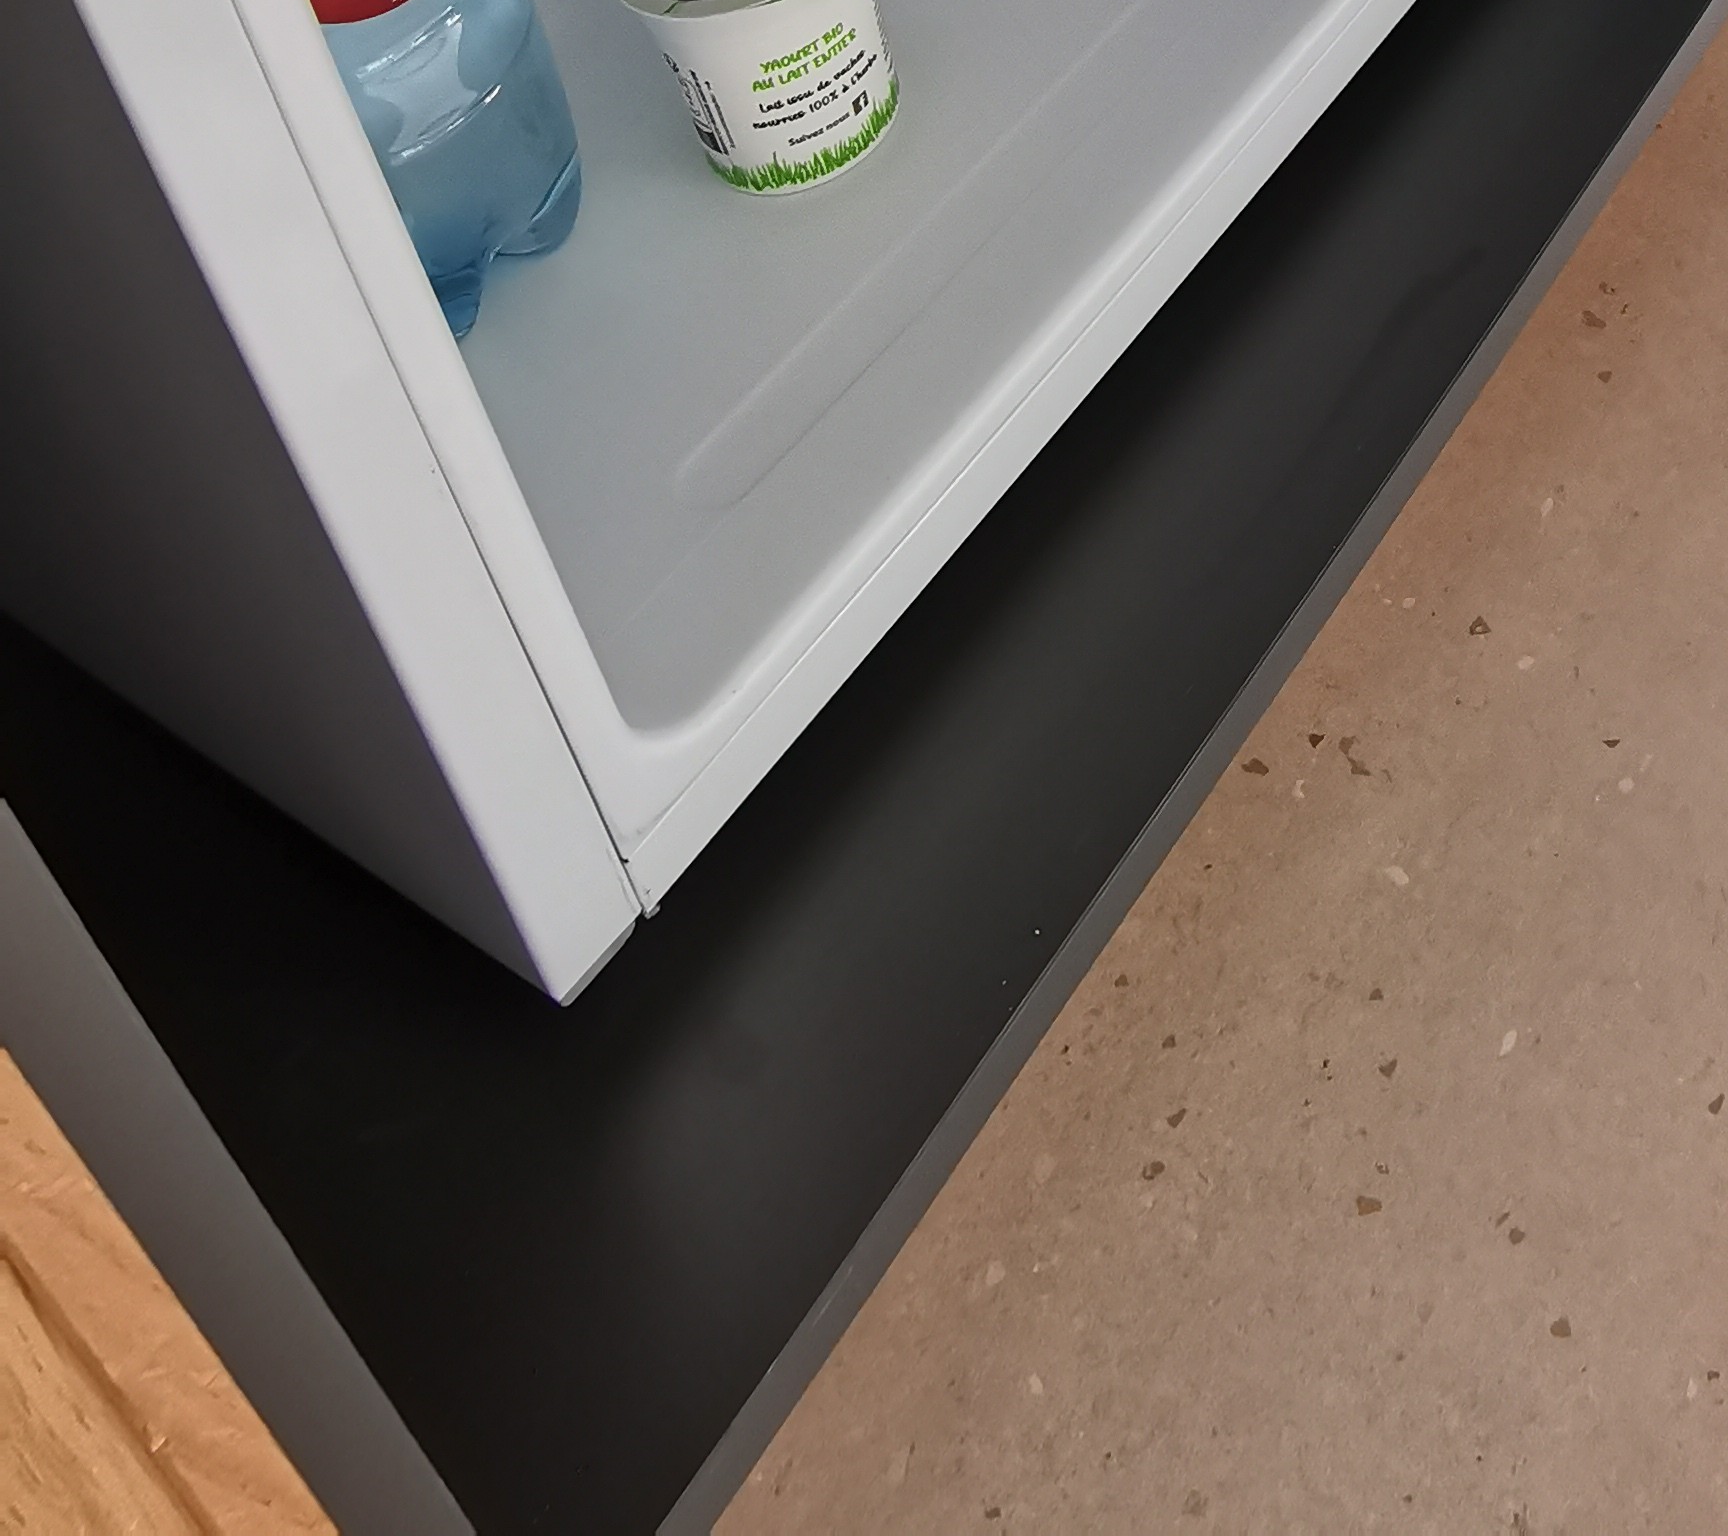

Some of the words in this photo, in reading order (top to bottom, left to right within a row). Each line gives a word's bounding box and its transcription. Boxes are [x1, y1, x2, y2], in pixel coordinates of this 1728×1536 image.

[760, 38, 820, 74] YAOURT
[822, 22, 844, 45] BIO
[752, 77, 775, 92] AU
[778, 61, 811, 85] LAIT
[817, 80, 832, 91] de
[809, 89, 839, 113] 100%
[788, 127, 824, 146] Suivez
